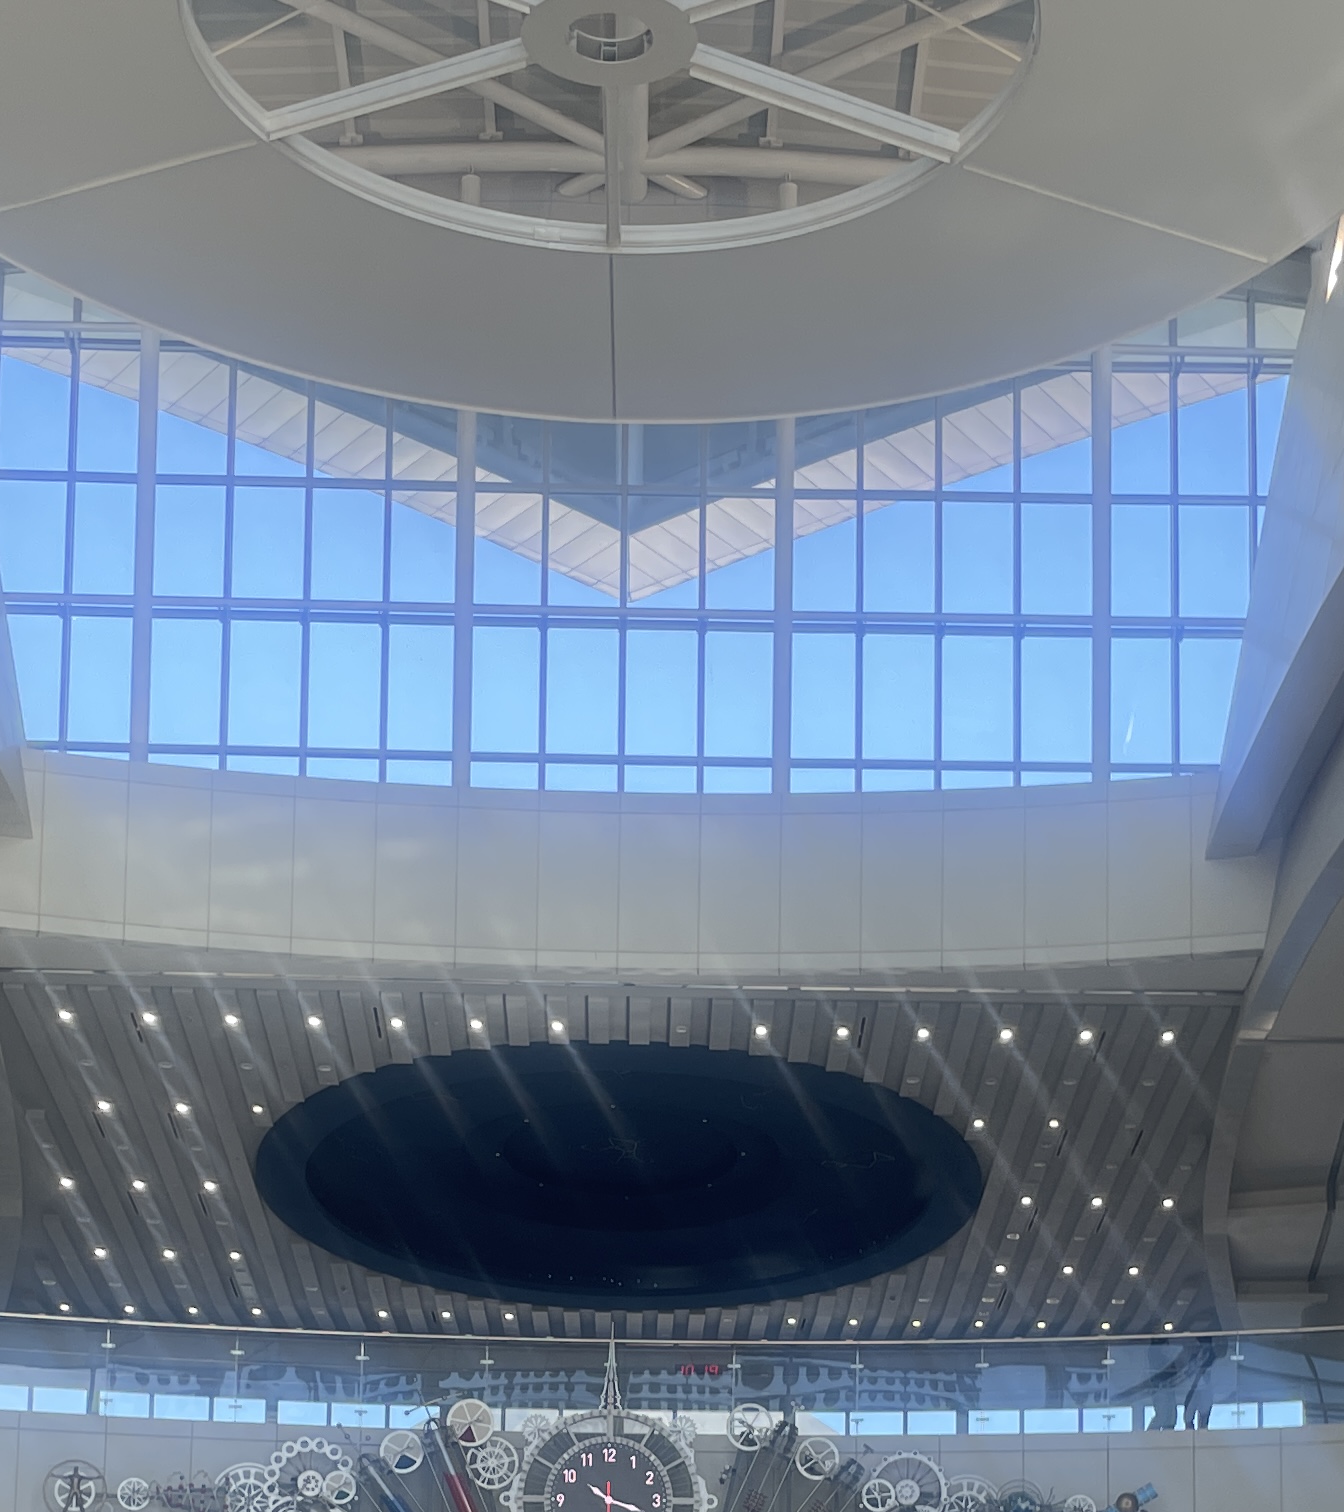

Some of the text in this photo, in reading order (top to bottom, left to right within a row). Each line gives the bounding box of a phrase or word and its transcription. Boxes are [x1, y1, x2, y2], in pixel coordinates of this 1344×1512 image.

[580, 1453, 593, 1467] 11
[603, 1448, 616, 1463] 12
[630, 1455, 637, 1469] 1
[563, 1469, 577, 1483] 10
[646, 1471, 654, 1485] 2
[556, 1493, 565, 1508] 9
[652, 1493, 661, 1508] 3
